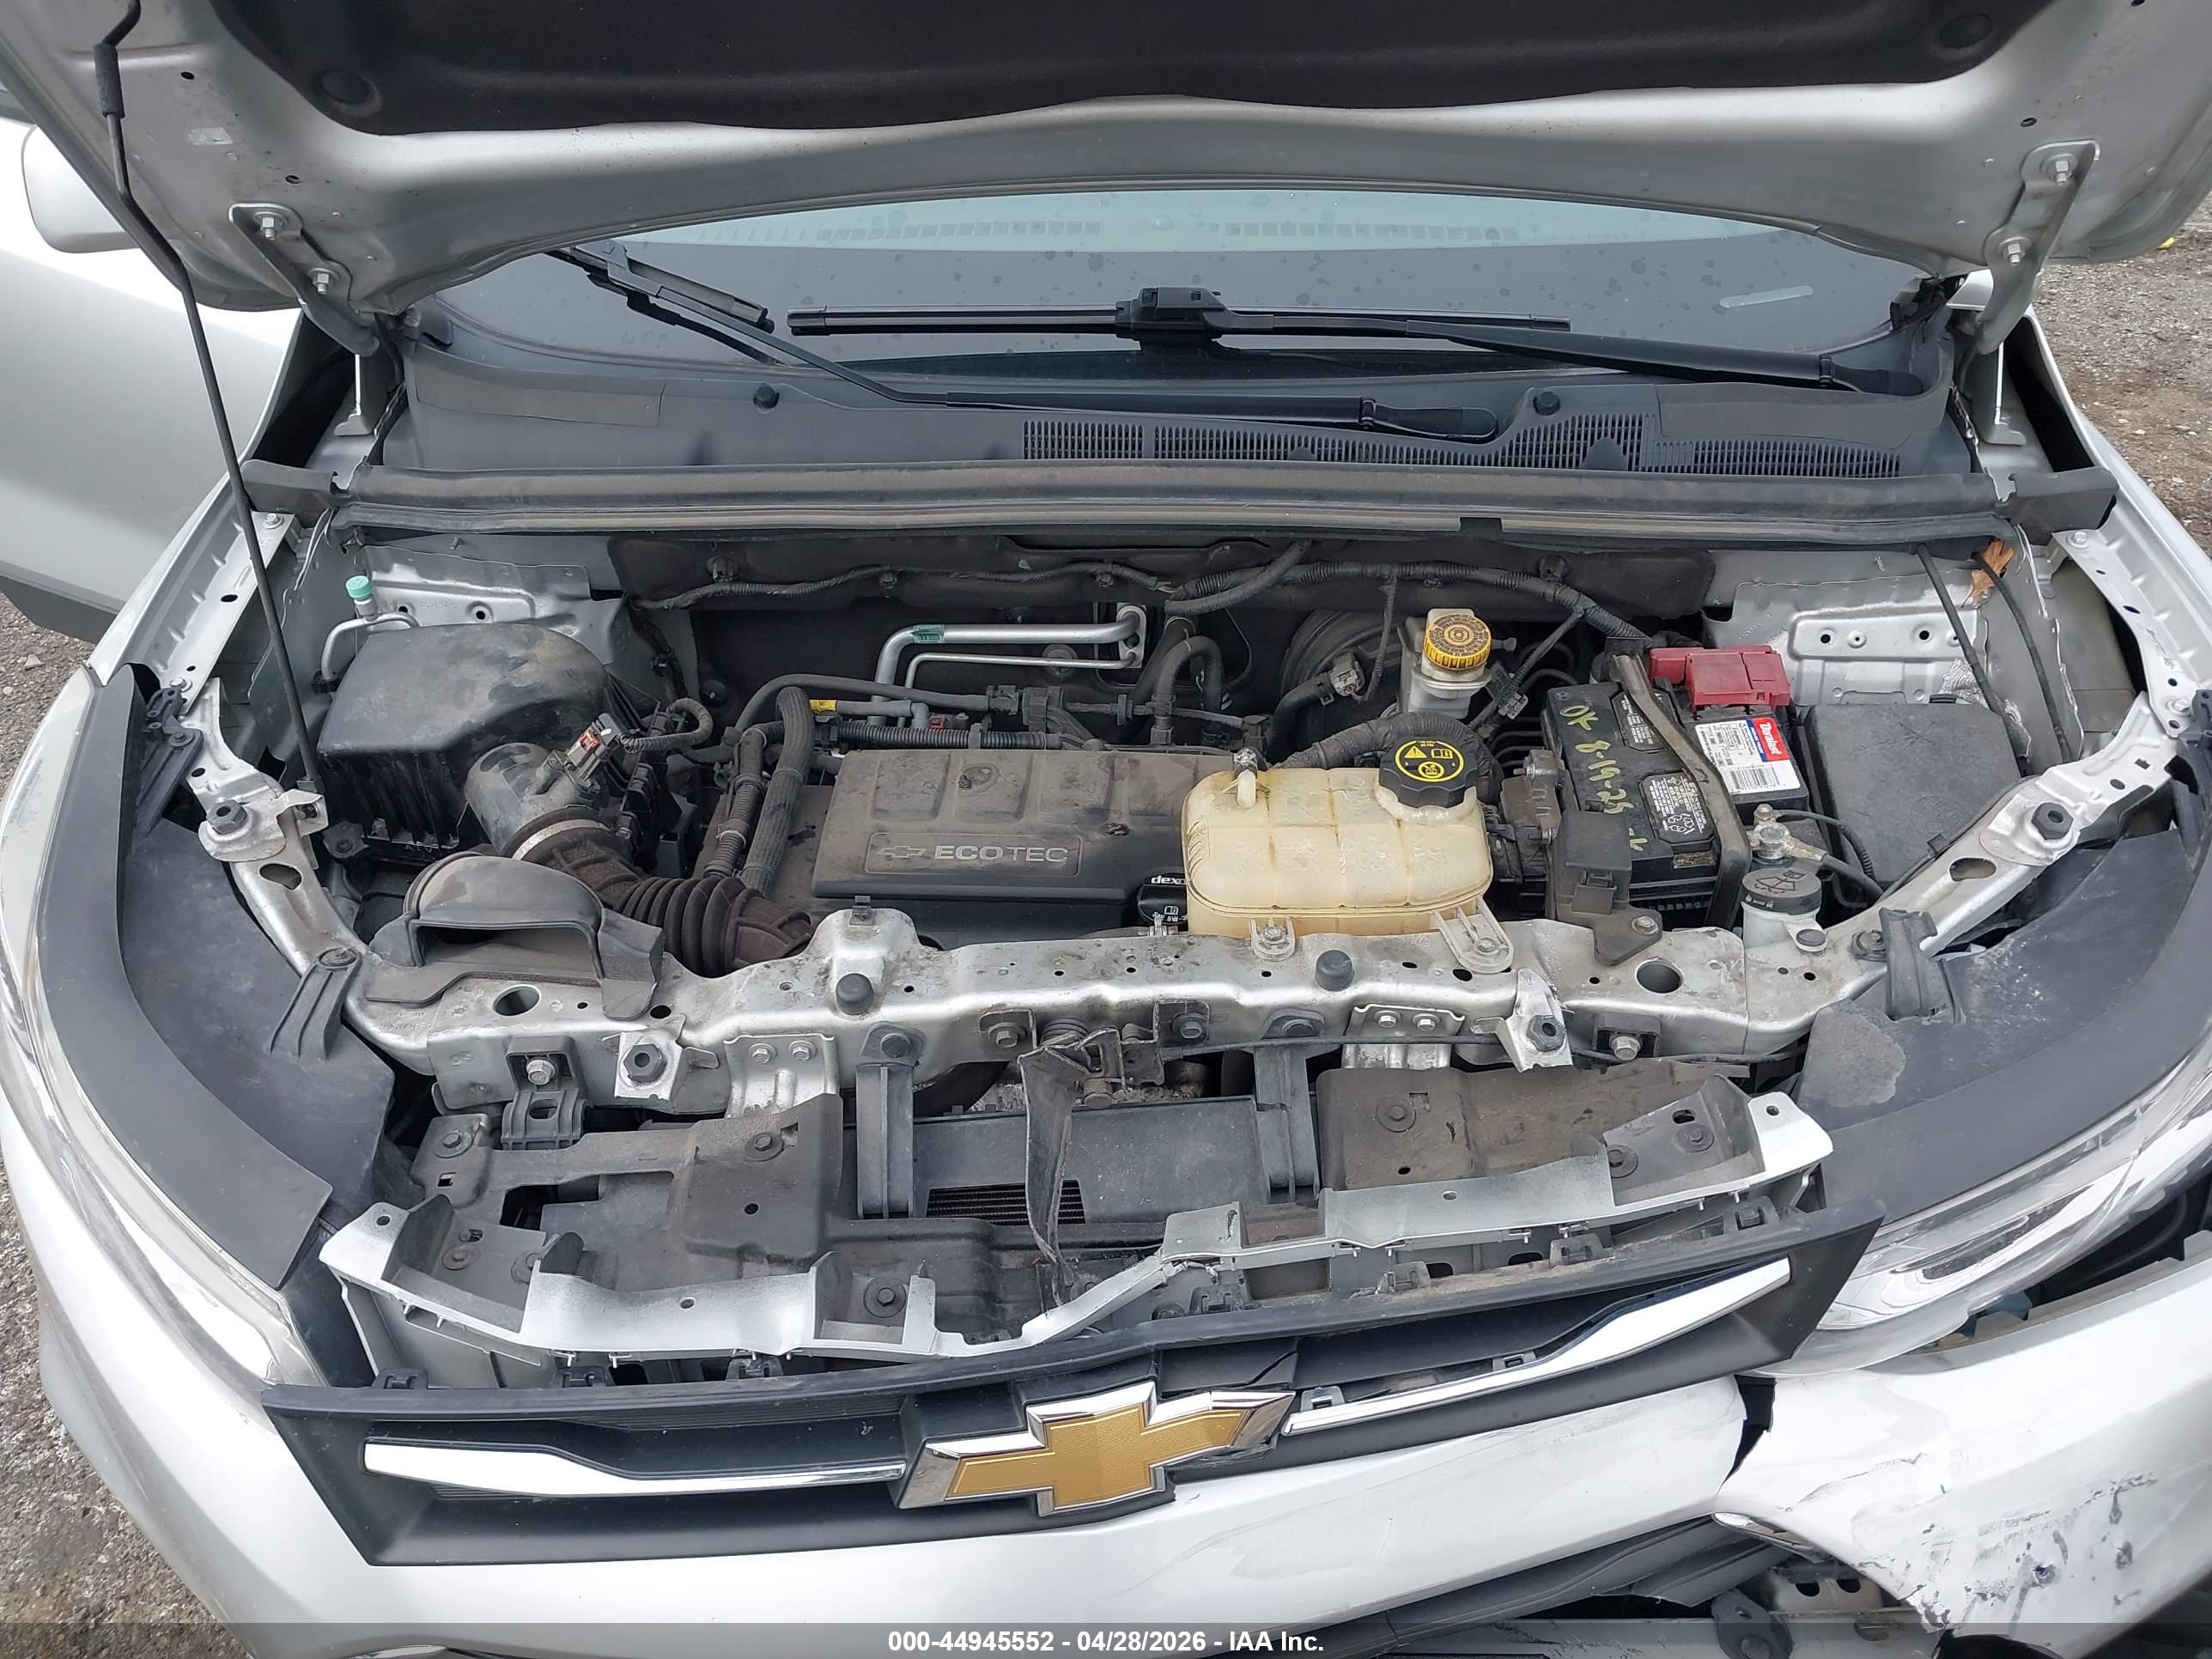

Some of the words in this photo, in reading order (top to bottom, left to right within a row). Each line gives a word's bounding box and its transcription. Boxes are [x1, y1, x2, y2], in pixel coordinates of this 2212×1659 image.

[1559, 705, 1600, 731] OK
[1759, 721, 1784, 756] Duralast
[934, 845, 1070, 863] ECOTEC
[1166, 914, 1188, 922] 5W-3
